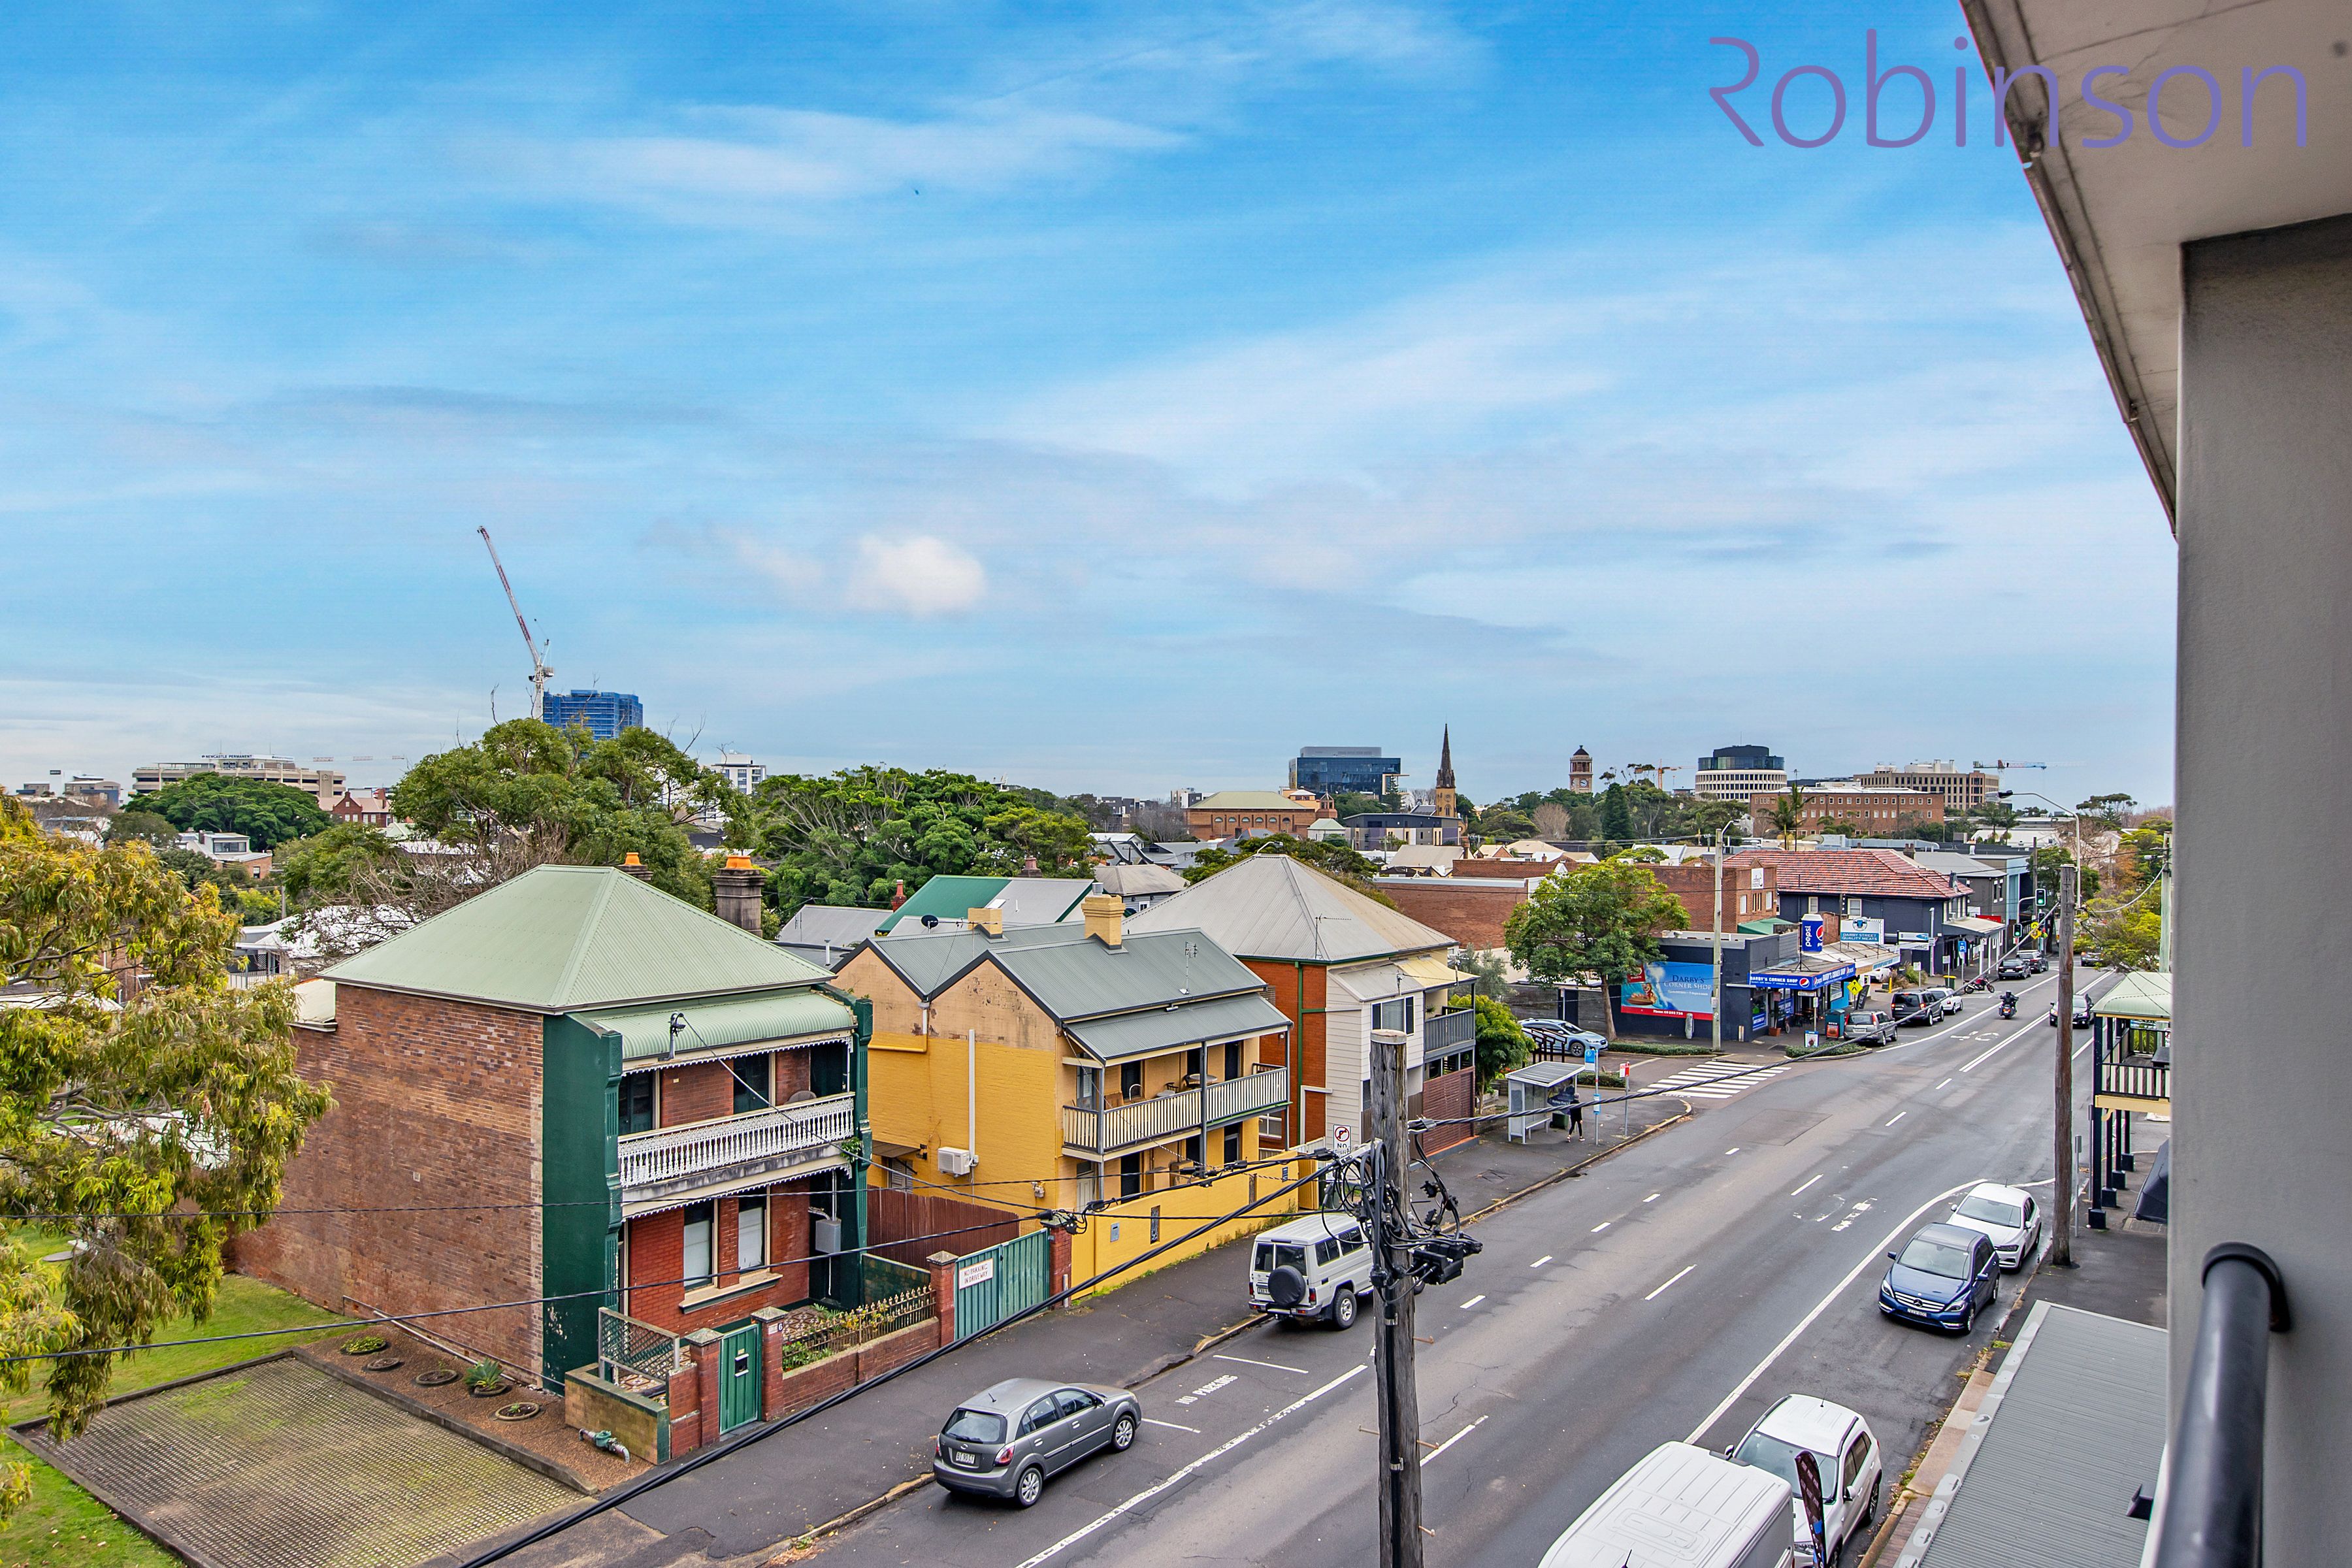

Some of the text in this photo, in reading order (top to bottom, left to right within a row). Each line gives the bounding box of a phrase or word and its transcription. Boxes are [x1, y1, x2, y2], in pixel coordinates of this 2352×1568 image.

[1673, 975, 1705, 983] DARBY'S
[970, 1264, 988, 1275] PARKING
[969, 1271, 988, 1282] DRIVEWAY
